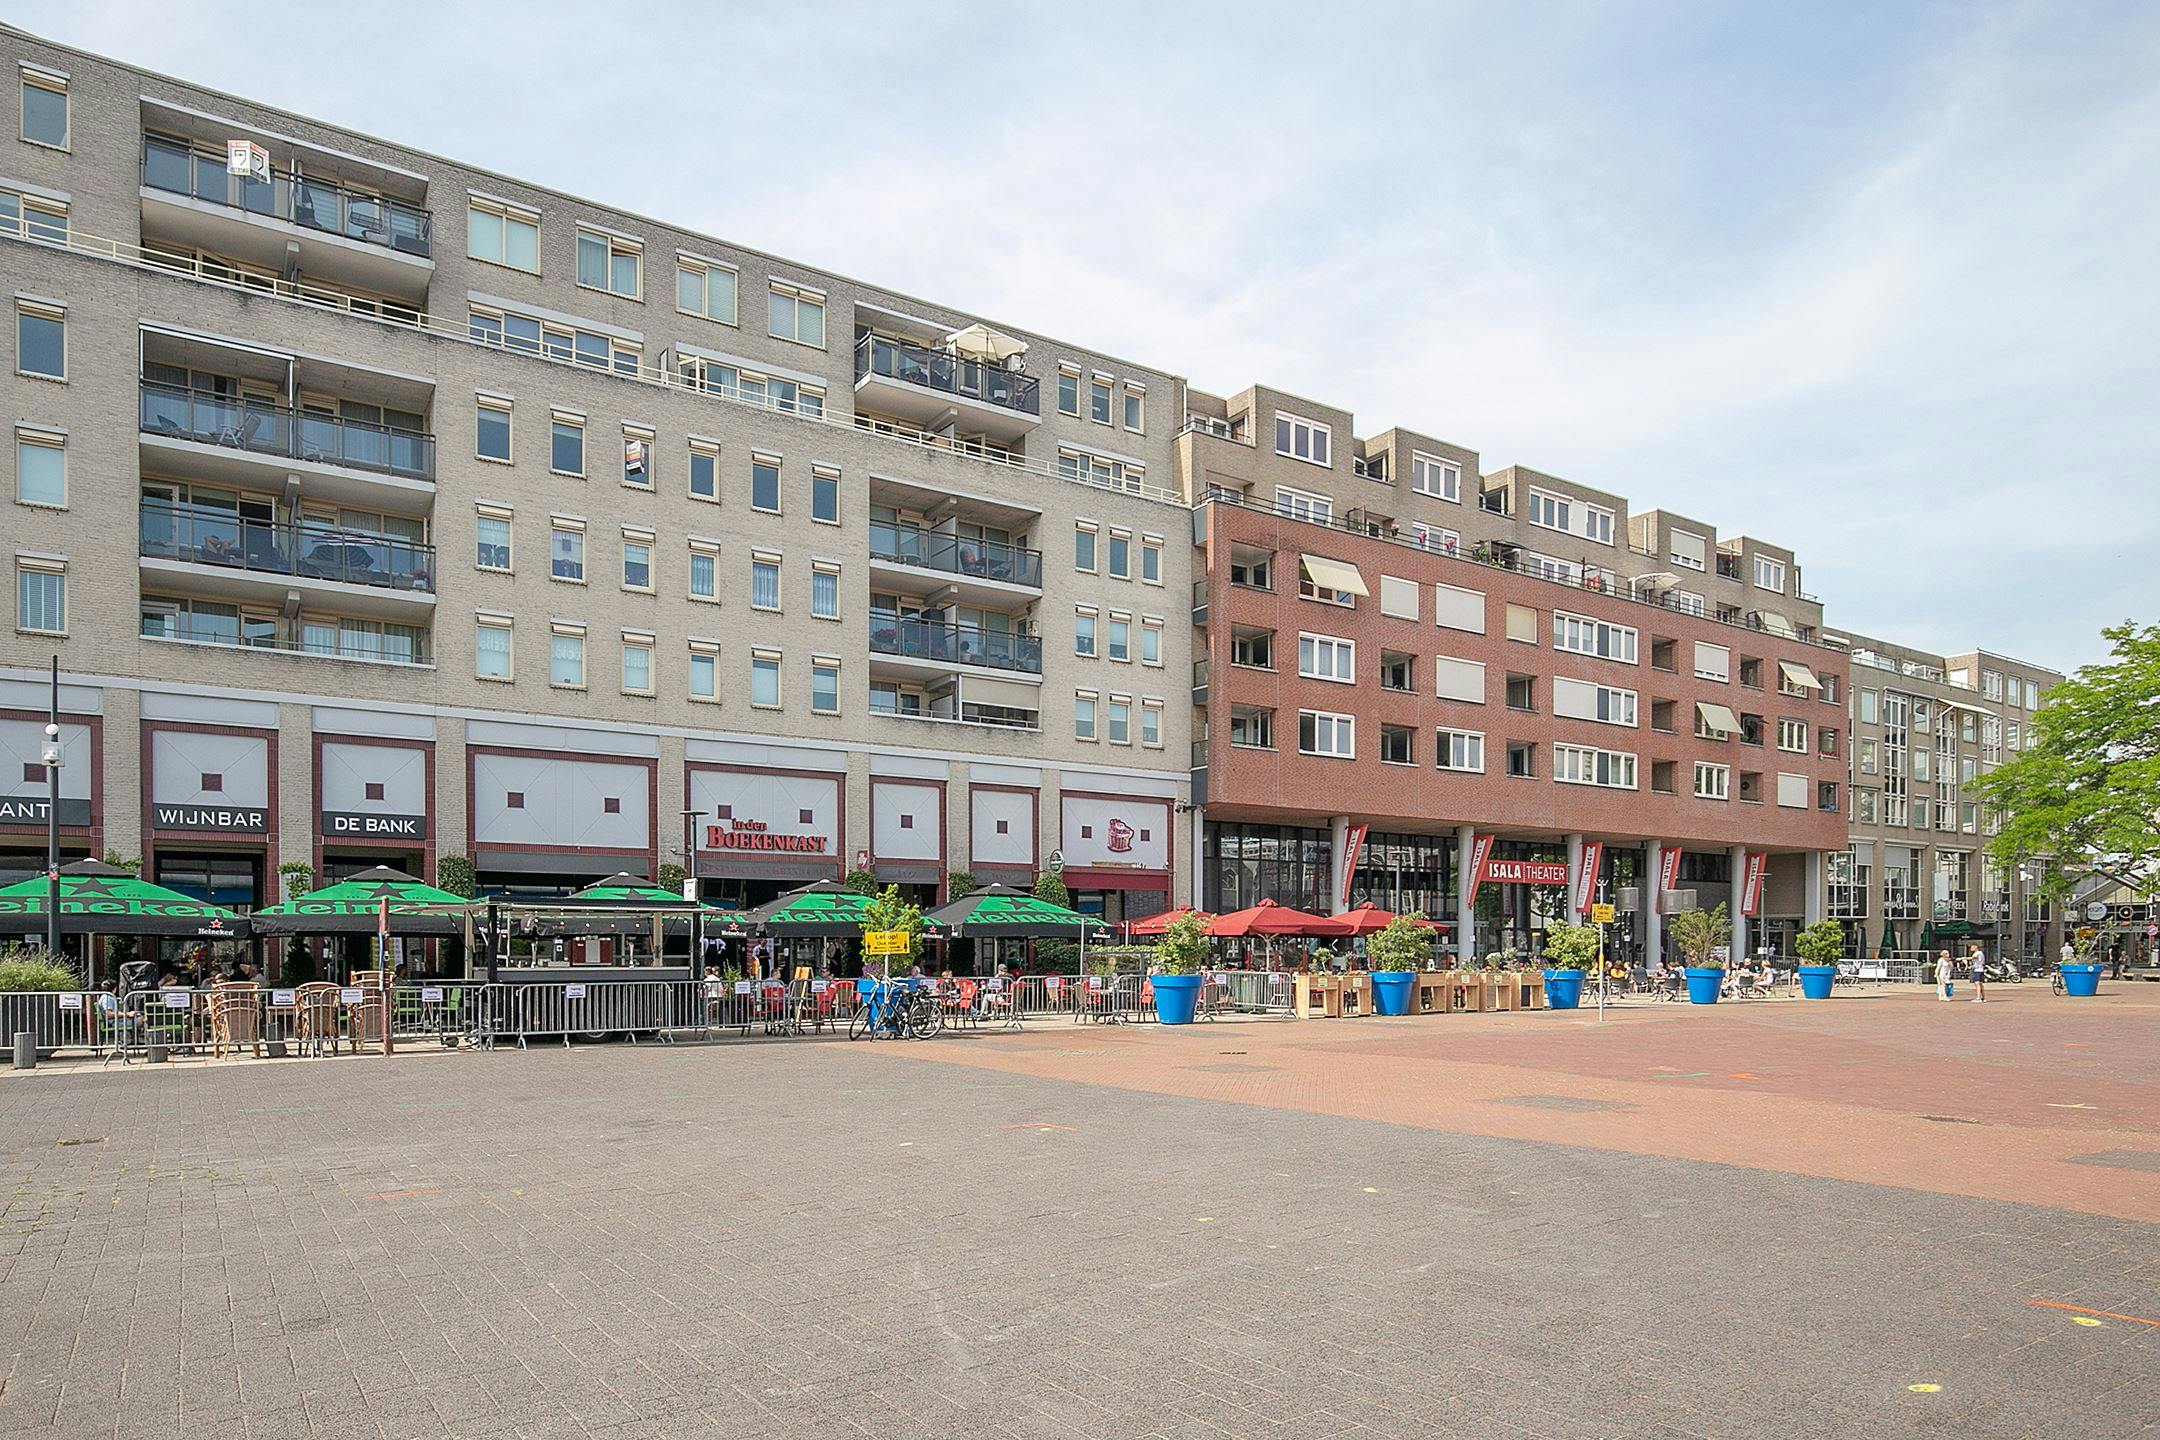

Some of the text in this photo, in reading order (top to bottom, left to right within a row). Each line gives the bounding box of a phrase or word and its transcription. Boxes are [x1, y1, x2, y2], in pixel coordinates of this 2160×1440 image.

[0, 803, 51, 818] ANT
[158, 808, 263, 827] WIJNBAR
[334, 817, 416, 834] DE BANK
[731, 818, 743, 831] in
[706, 825, 828, 852] BOEKENKAST
[1489, 863, 1565, 881] ISALA THEATER
[1584, 854, 1593, 876] ISALA
[198, 928, 235, 936] Heineken
